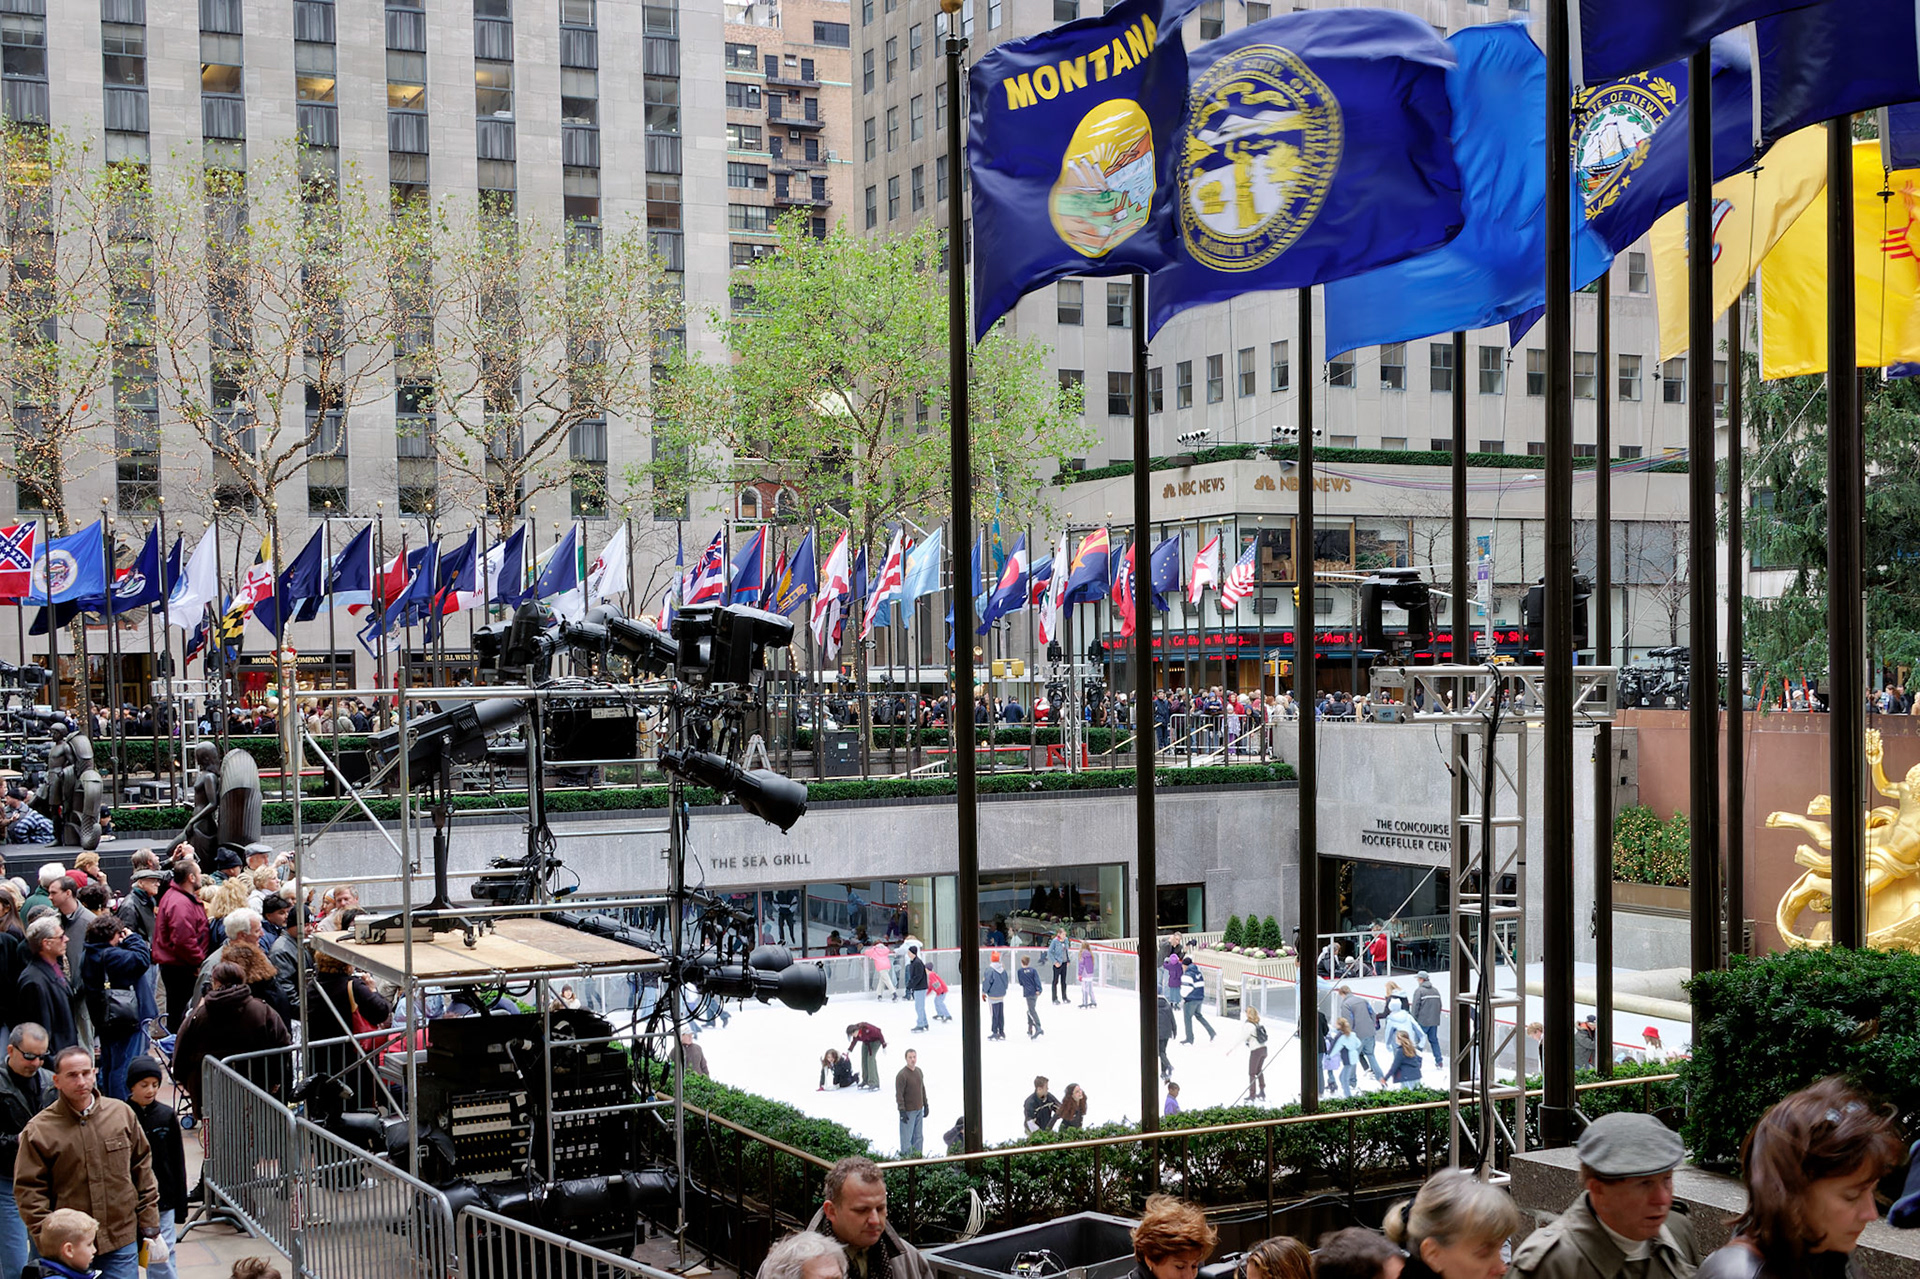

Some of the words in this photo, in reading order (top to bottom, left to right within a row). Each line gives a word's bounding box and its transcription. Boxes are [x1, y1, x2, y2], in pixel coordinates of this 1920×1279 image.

[1610, 92, 1623, 102] OF
[1629, 94, 1657, 114] NEW
[1178, 482, 1197, 496] NBC
[1200, 477, 1225, 493] NEWS
[1313, 477, 1351, 492] NEWS
[1376, 819, 1392, 830] THE
[1394, 821, 1449, 835] CONCOURSE
[1361, 834, 1424, 850] ROCKEFELLER
[711, 857, 737, 869] THE
[742, 856, 768, 868] SEA
[773, 854, 810, 866] GRILL
